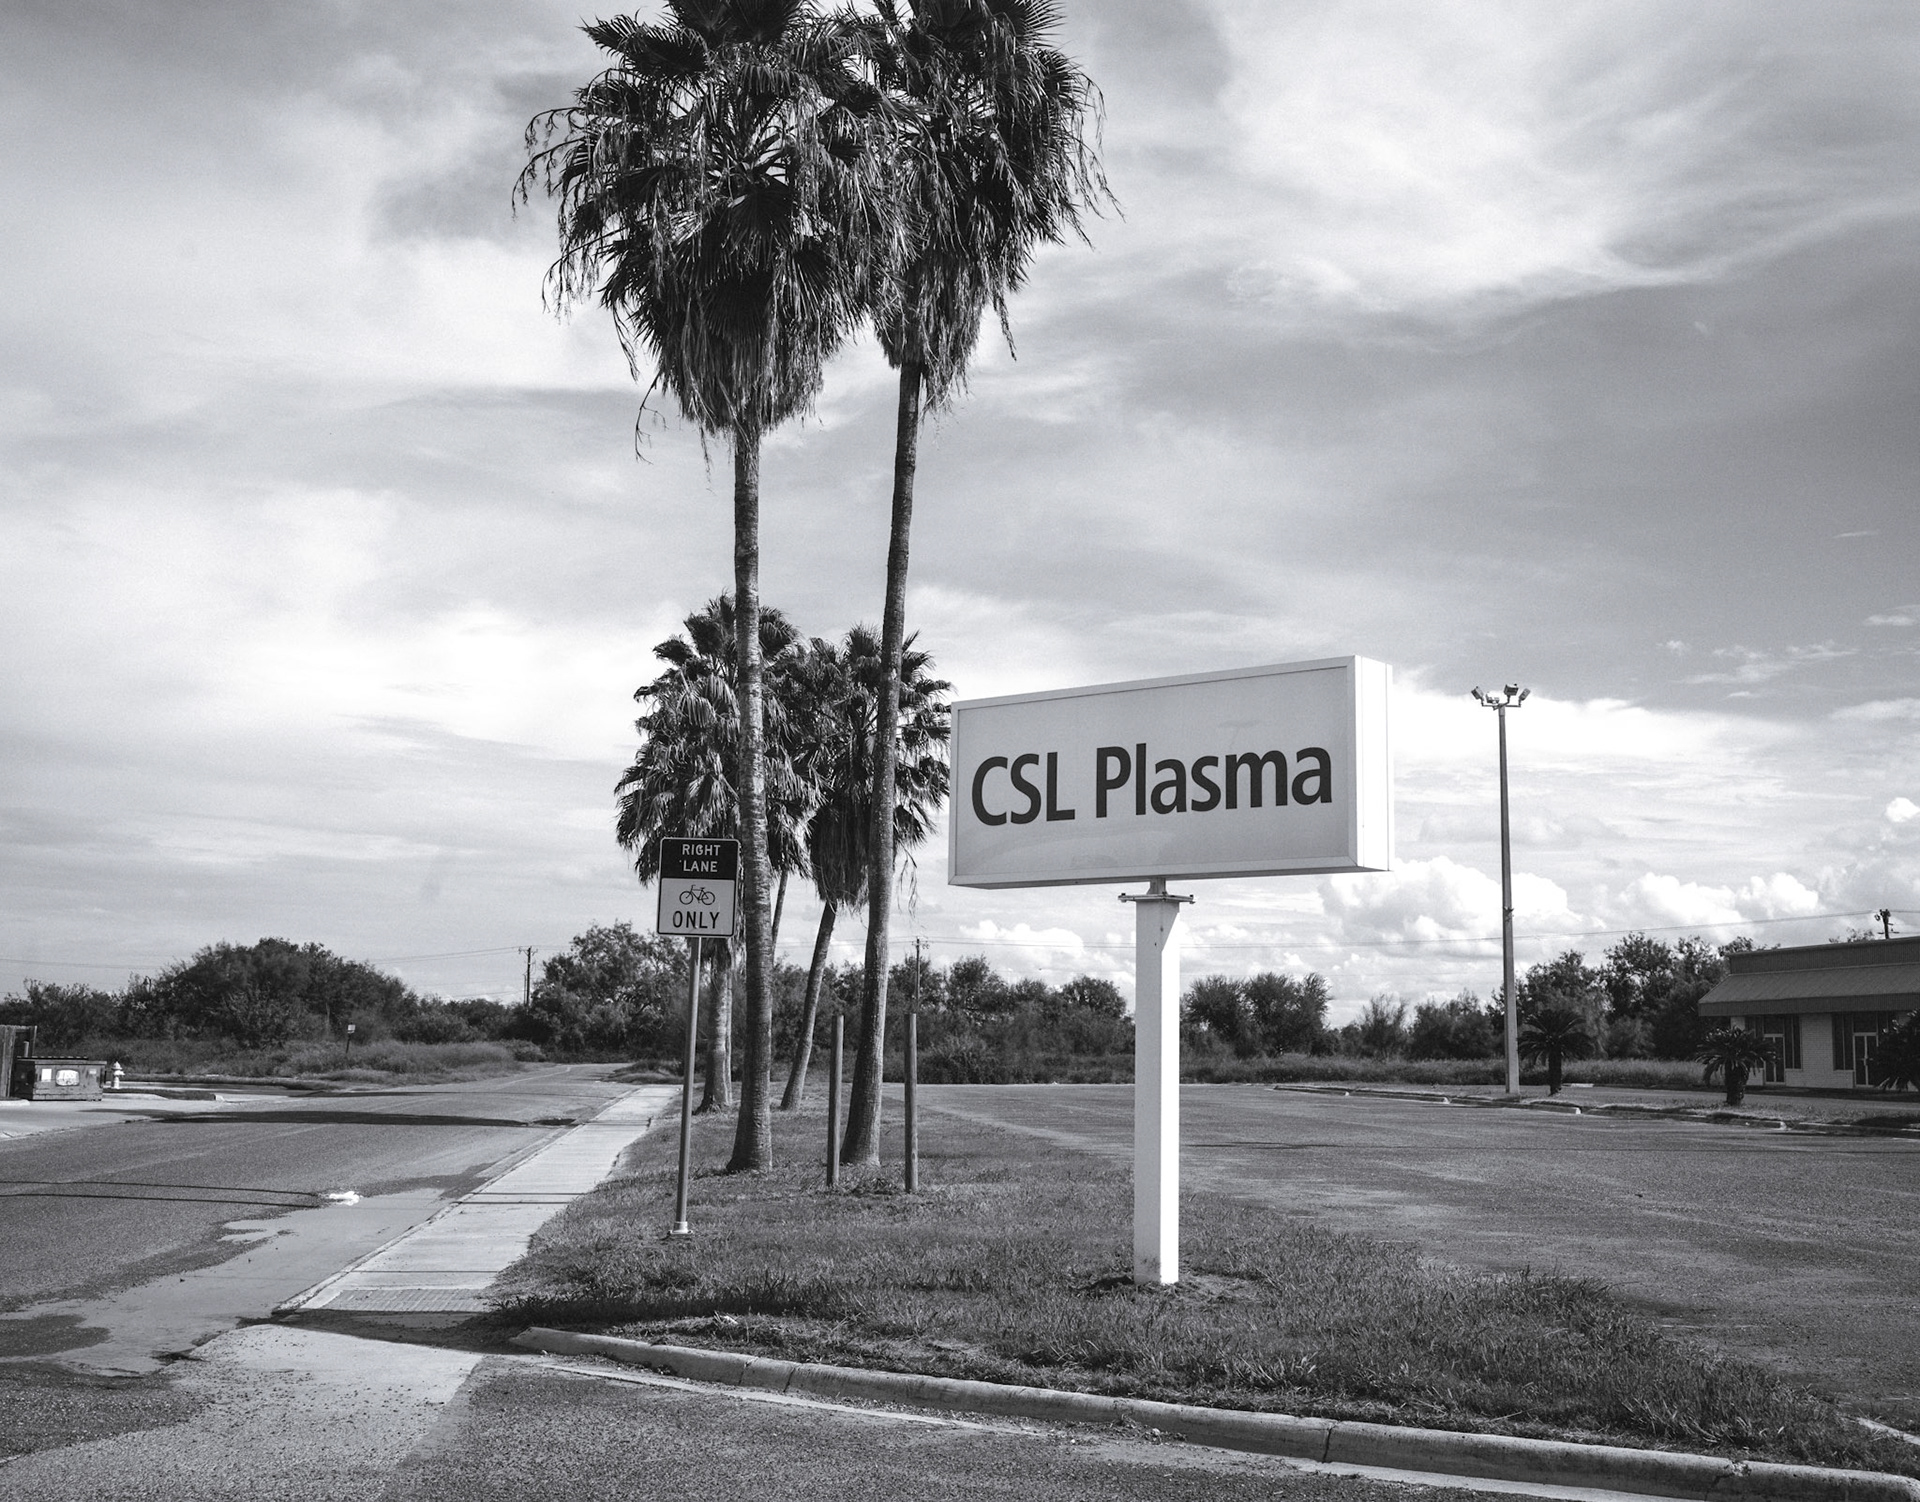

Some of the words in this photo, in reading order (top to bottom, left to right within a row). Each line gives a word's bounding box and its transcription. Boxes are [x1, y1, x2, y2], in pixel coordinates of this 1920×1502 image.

[972, 752, 1076, 826] CSL
[1096, 743, 1332, 818] Plasma
[682, 844, 721, 856] RIGHT
[683, 860, 718, 872] LANE
[672, 910, 720, 929] ONLY
